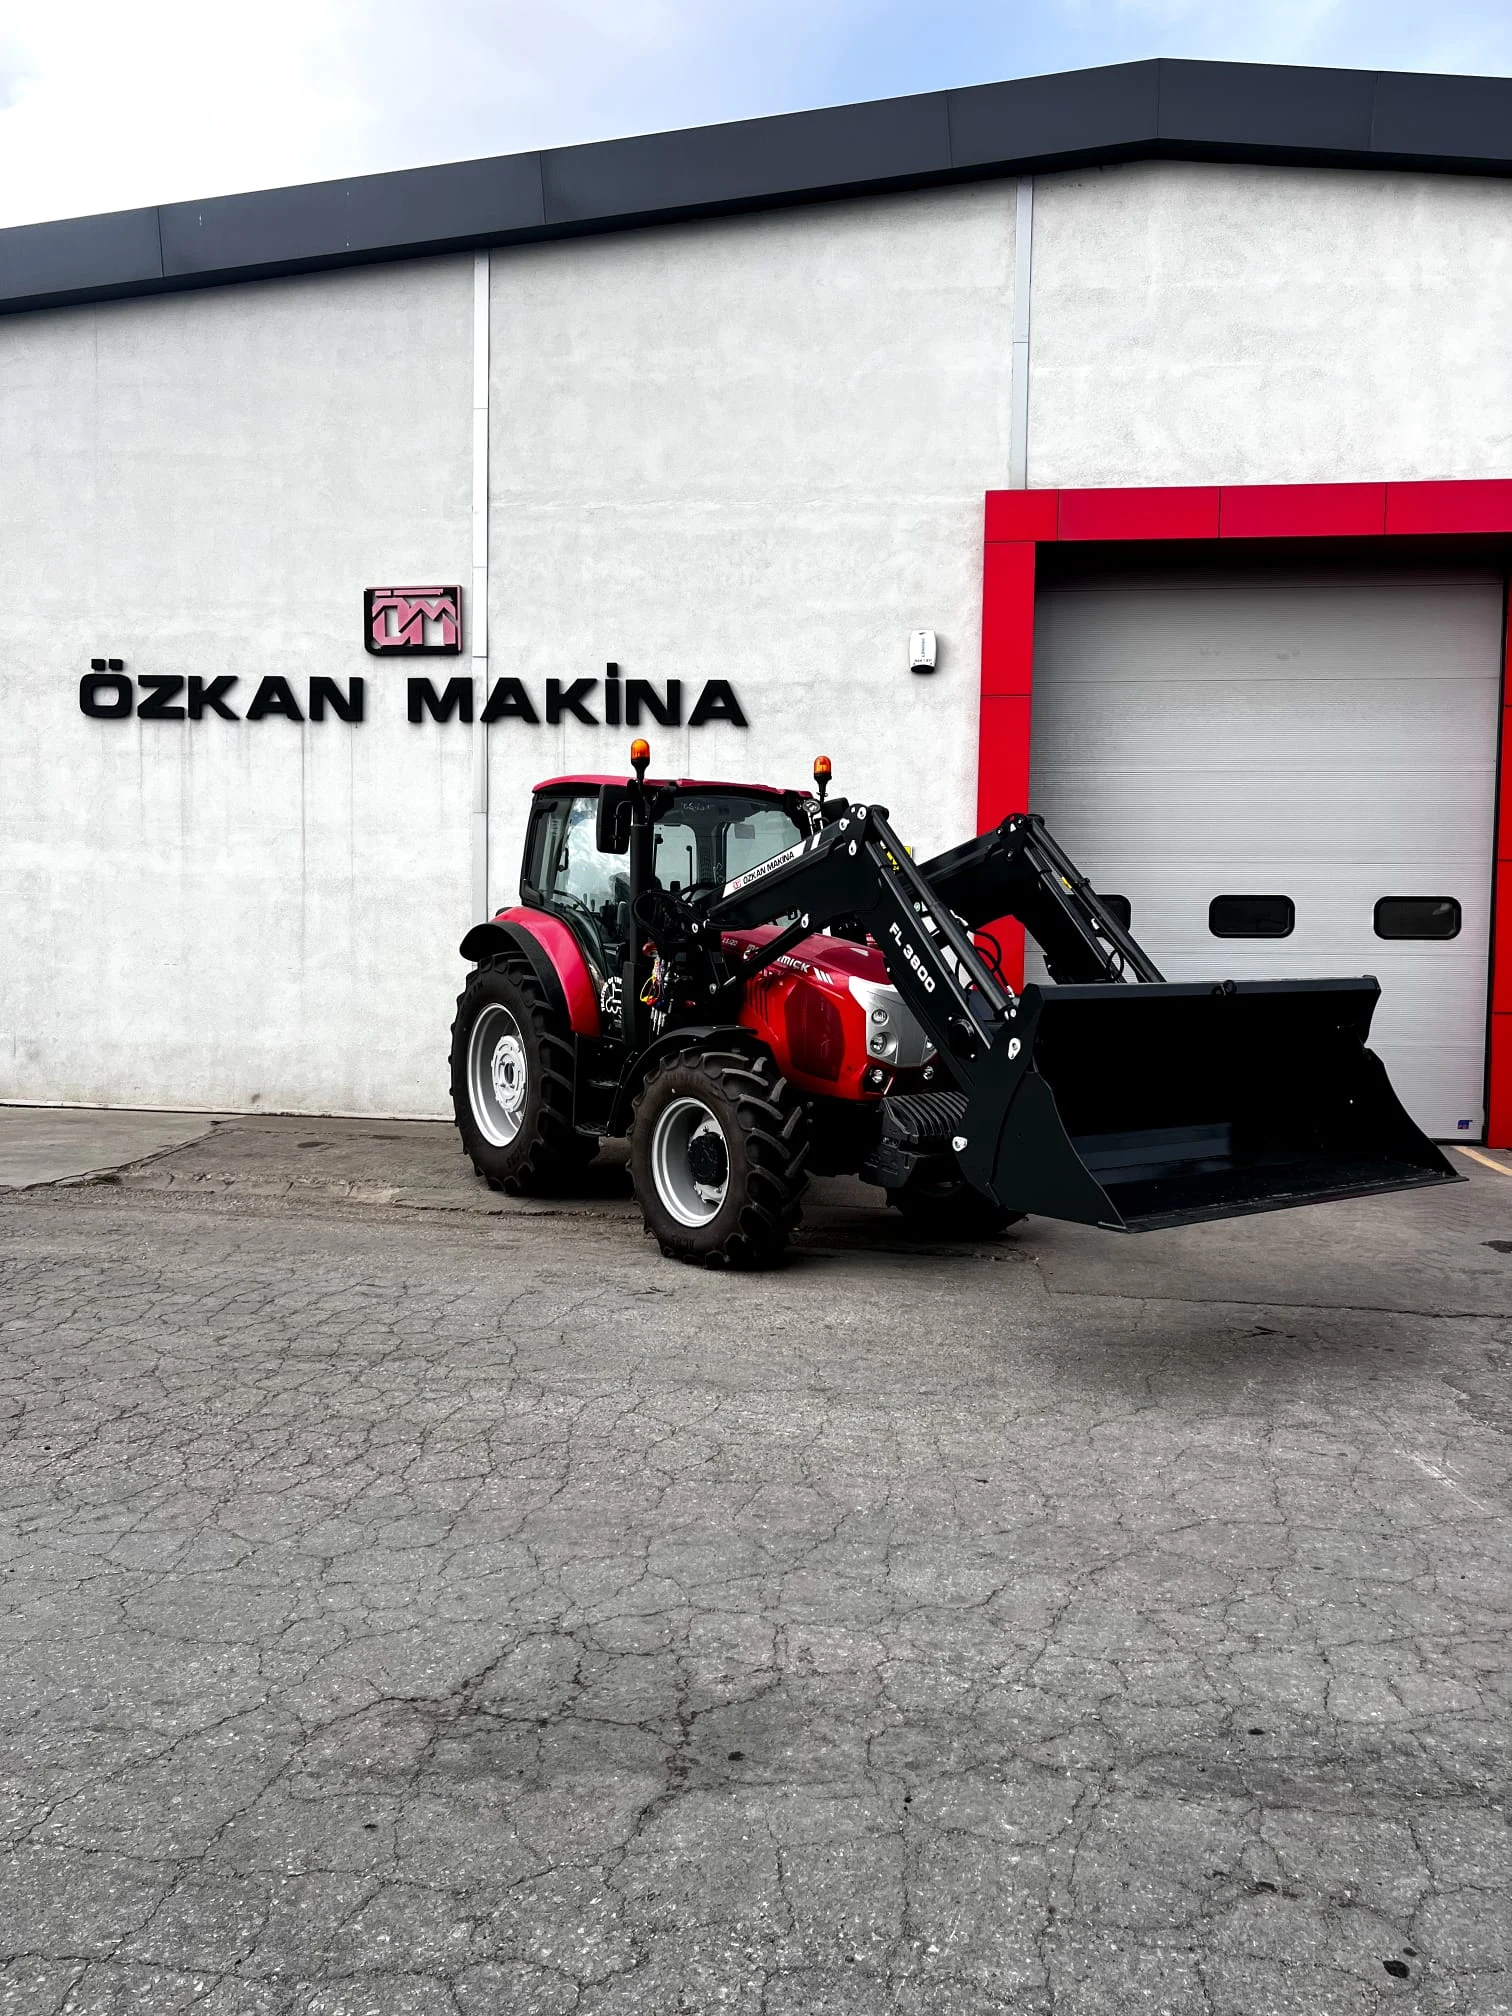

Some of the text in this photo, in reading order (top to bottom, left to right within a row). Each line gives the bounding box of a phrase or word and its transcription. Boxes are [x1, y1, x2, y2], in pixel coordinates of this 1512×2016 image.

[79, 658, 749, 726] ÖZKAN MAKİNA
[889, 921, 935, 993] FL 3800
